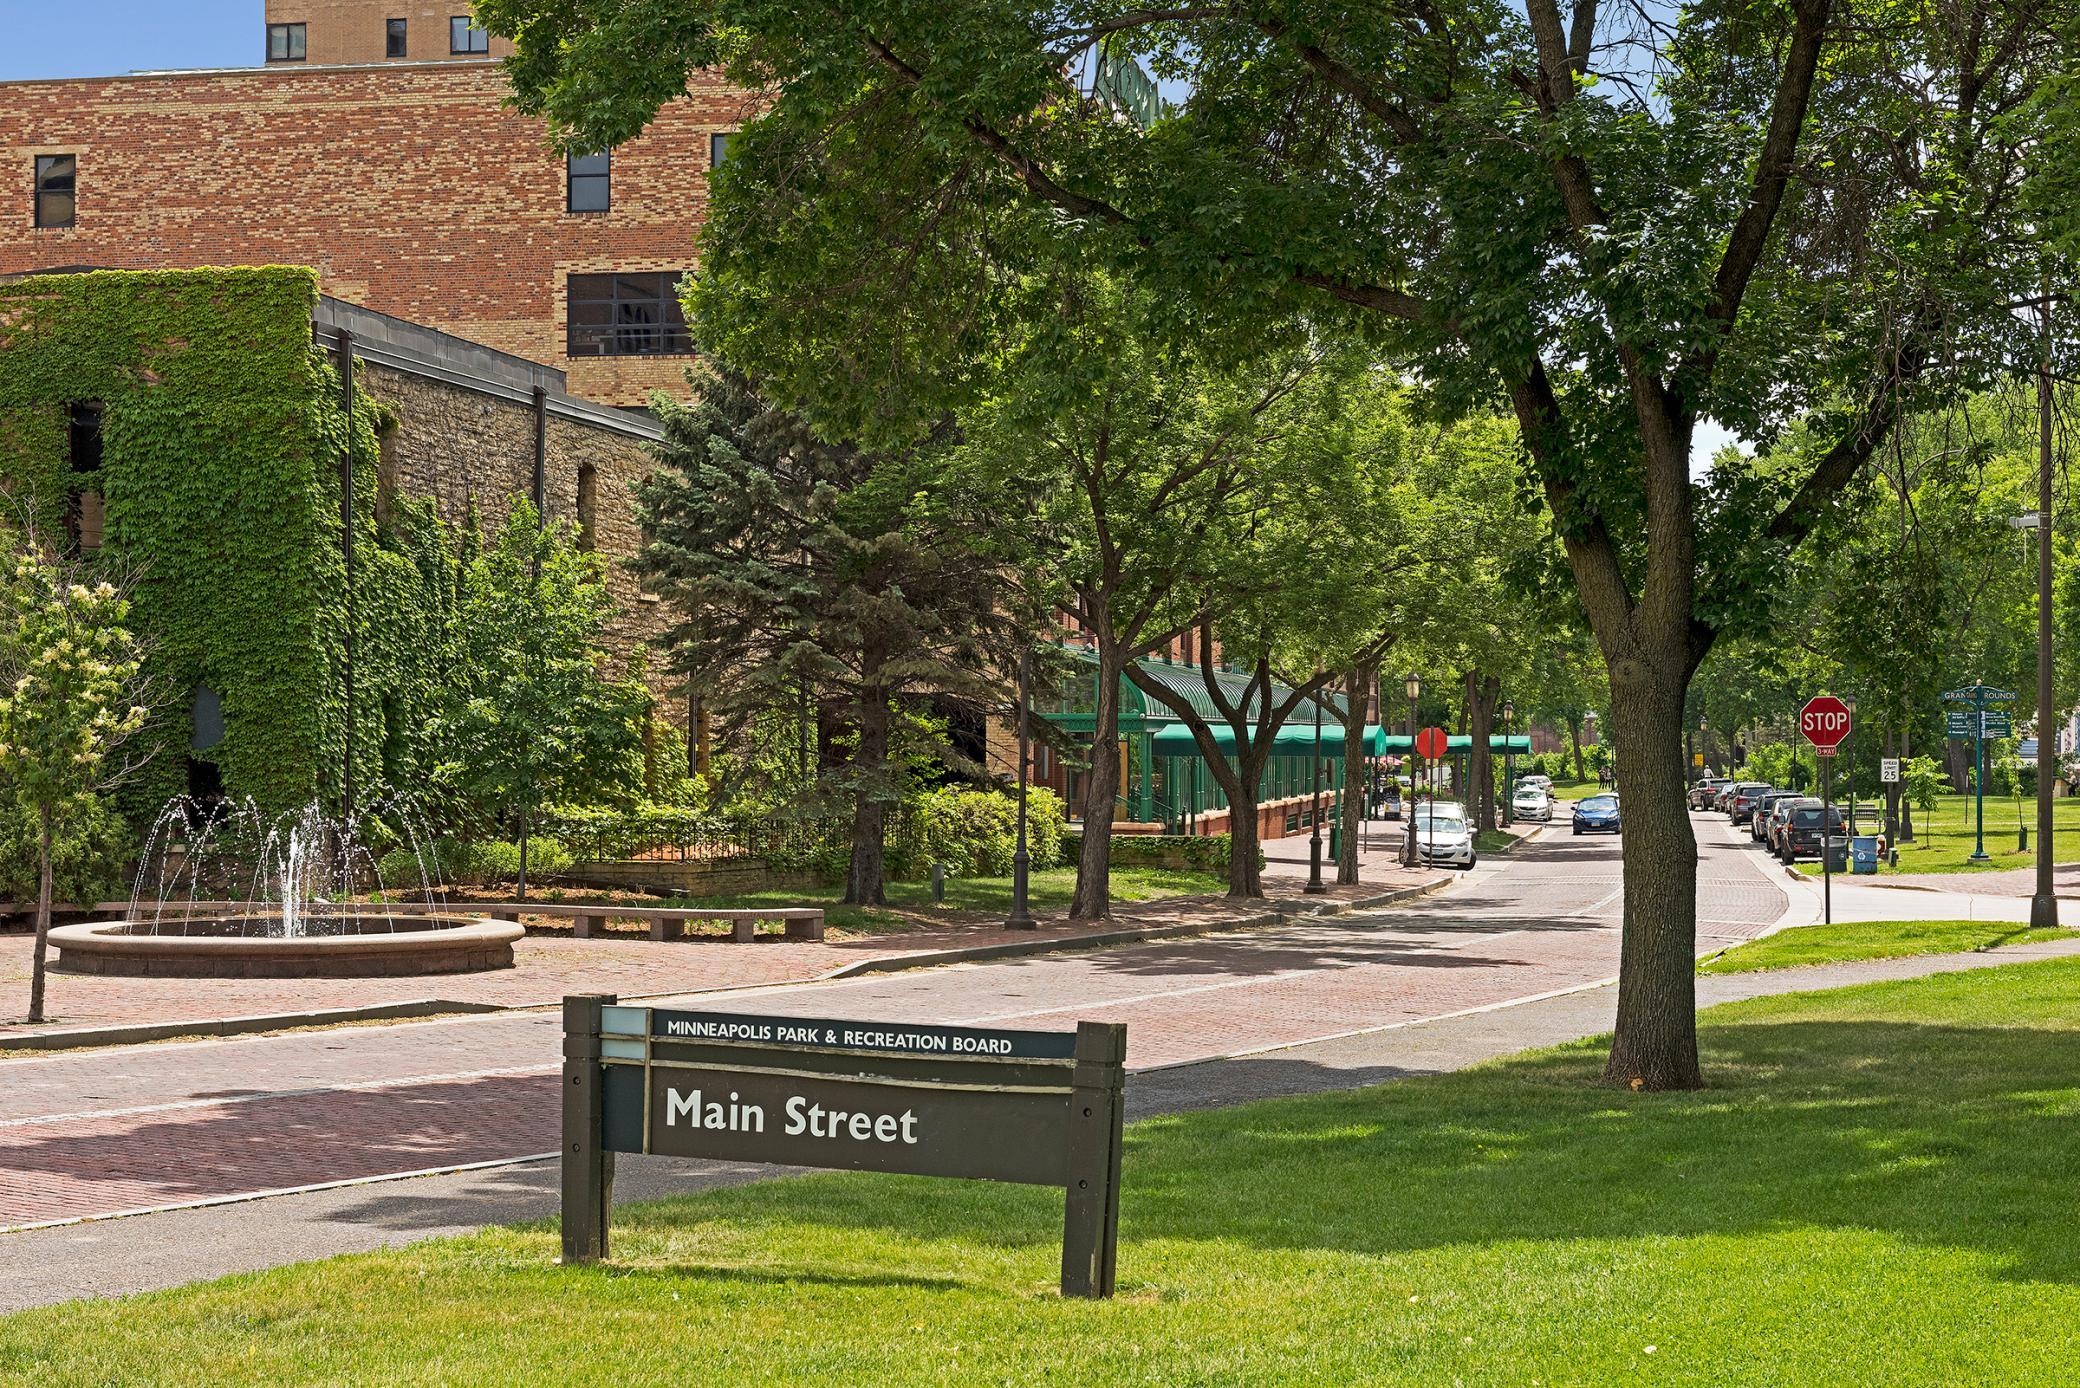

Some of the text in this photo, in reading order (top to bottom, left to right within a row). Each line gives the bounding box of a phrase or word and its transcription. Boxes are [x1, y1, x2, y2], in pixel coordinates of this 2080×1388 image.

[1944, 692, 2016, 701] GRAN ROUNDS
[1804, 712, 1847, 731] STOP
[1884, 770, 1896, 780] 25
[667, 1021, 1012, 1054] MINNEAPOLIS PARK & RECREATION BOARD
[666, 1087, 918, 1144] Main Street
